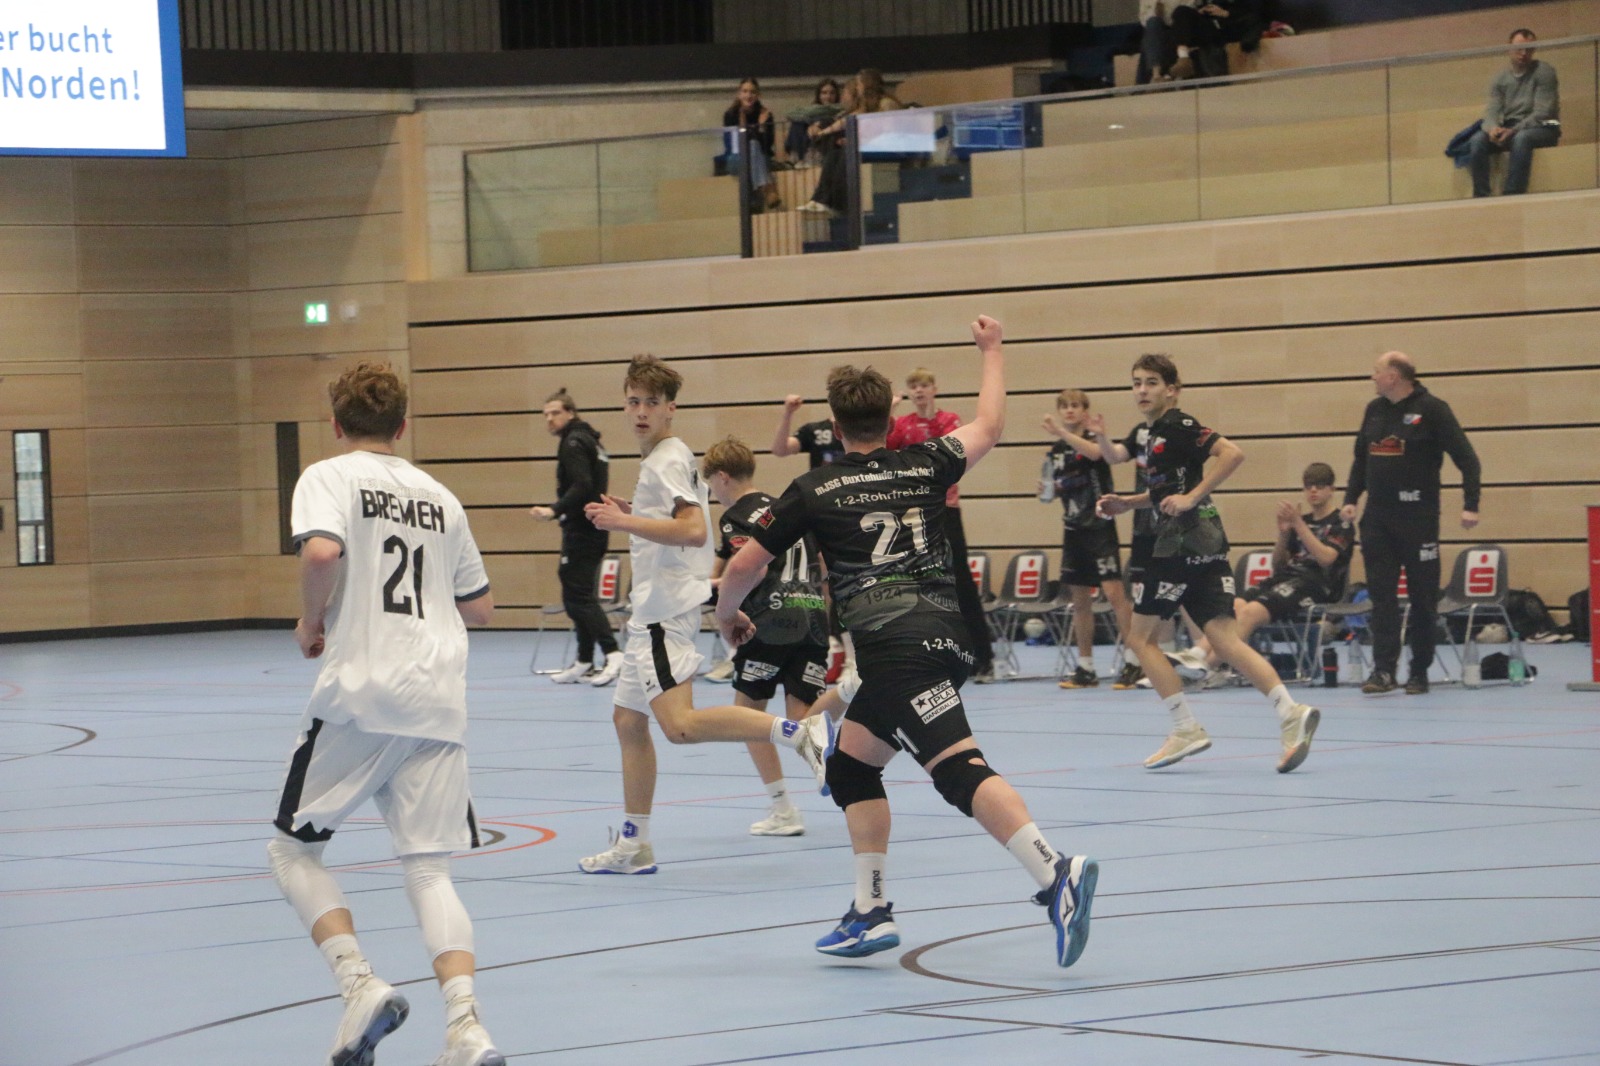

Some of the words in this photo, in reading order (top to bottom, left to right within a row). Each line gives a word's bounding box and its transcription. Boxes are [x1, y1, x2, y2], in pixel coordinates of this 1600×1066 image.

[29, 23, 113, 54] bucht
[2, 66, 140, 101] Norden!
[814, 429, 832, 445] 39
[814, 478, 842, 496] mJSG
[834, 485, 930, 508] 1-2-Rohrfrei.de
[360, 488, 445, 534] BREMEN
[860, 507, 928, 566] 21
[383, 534, 425, 620] 21
[933, 687, 955, 705] PLAY
[1033, 839, 1055, 864] Kempa
[871, 869, 882, 899] Kempa
